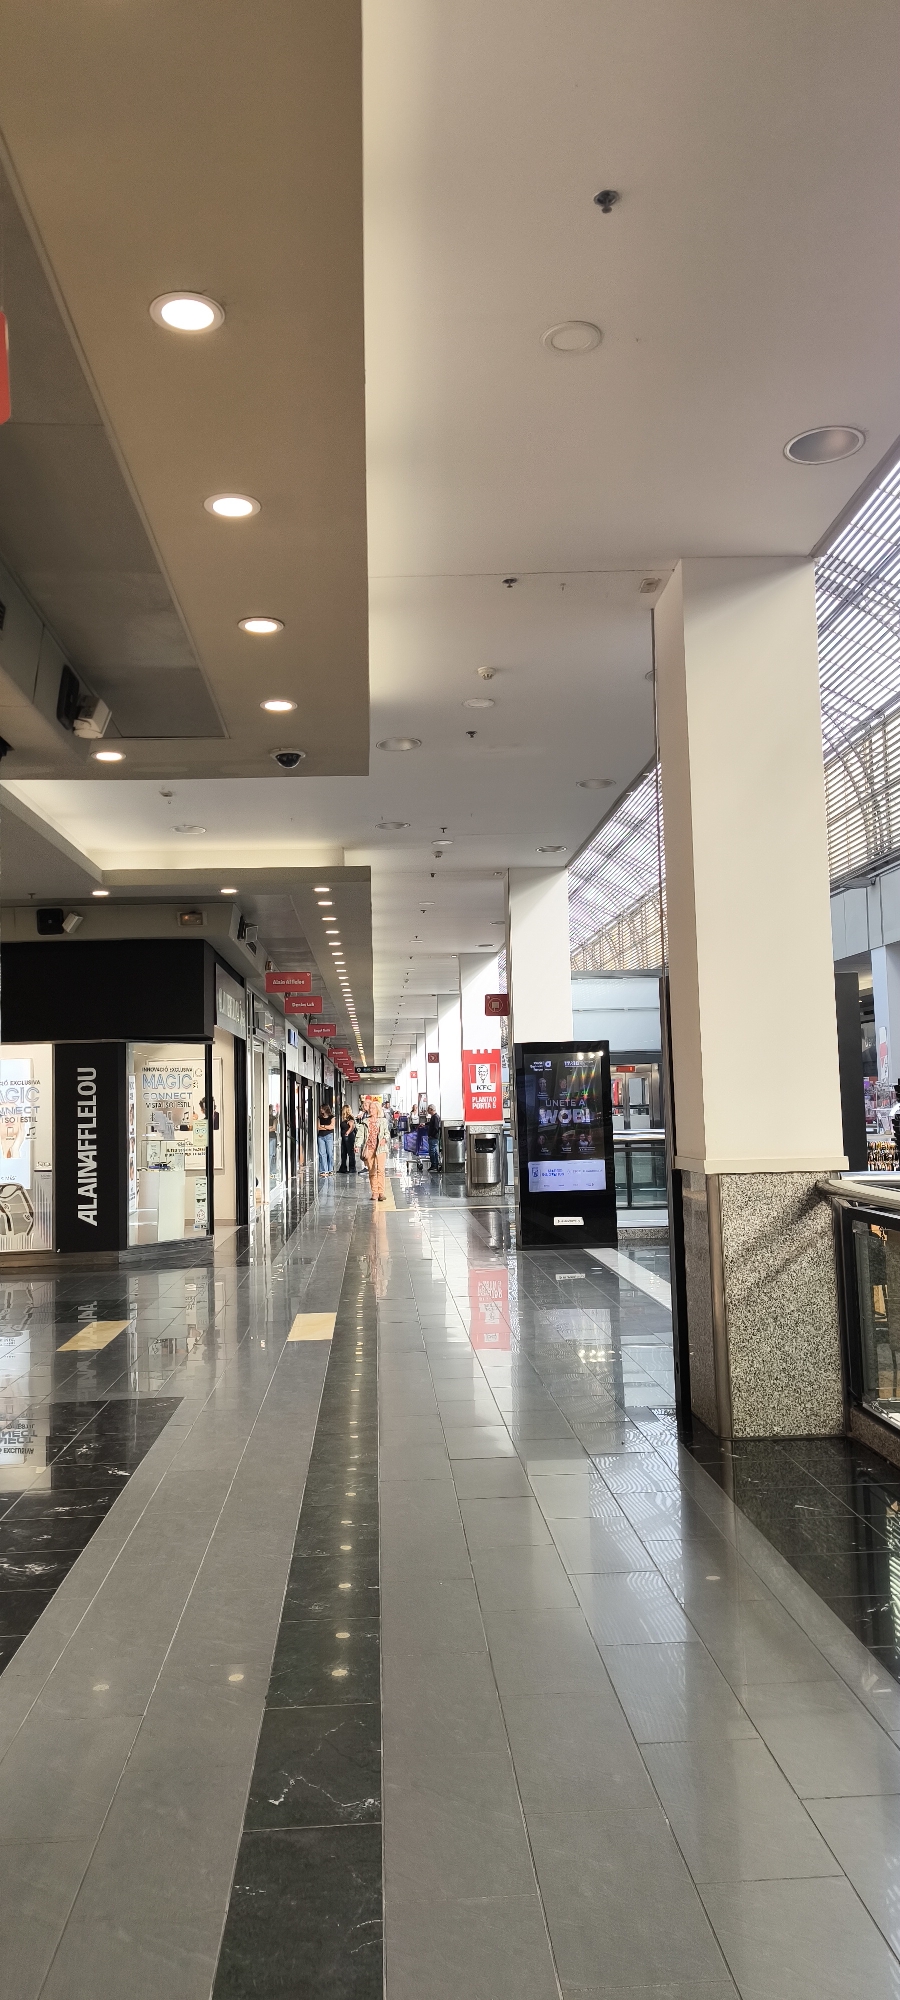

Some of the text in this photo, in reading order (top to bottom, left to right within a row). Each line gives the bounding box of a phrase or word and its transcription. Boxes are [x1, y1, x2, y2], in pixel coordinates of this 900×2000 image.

[142, 1073, 193, 1090] MAGIC
[142, 1092, 193, 1100] CONNECT
[145, 1101, 161, 1109] VISTA
[472, 1102, 491, 1110] PORTA
[545, 1097, 577, 1107] ÚNETE
